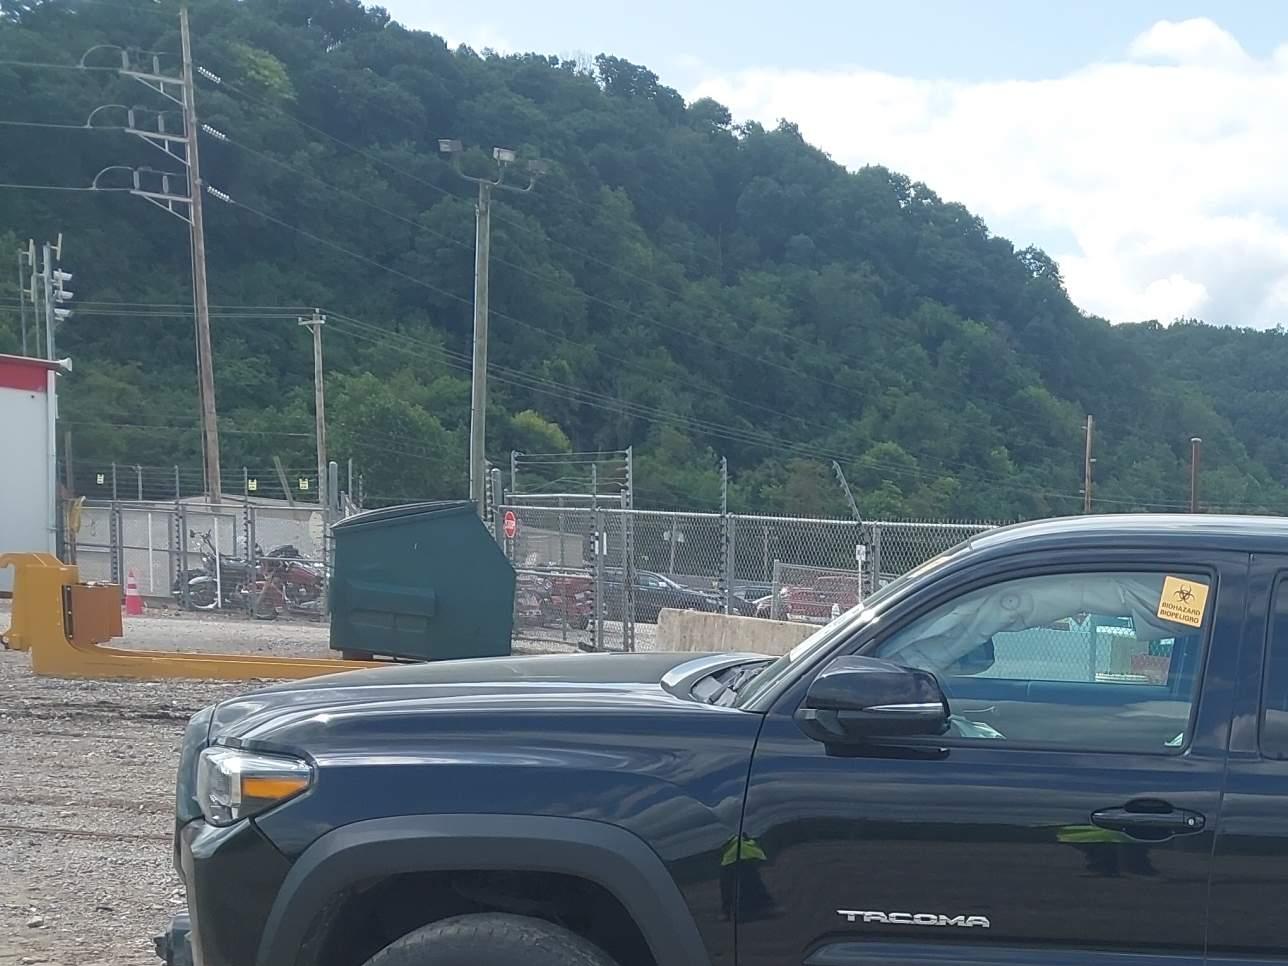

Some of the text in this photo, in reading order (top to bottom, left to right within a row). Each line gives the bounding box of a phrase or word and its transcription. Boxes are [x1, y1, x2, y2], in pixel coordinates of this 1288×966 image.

[1160, 609, 1199, 624] BIOPELIGRO
[1162, 602, 1201, 616] BIOHAZARD
[836, 909, 991, 929] TACOMA
